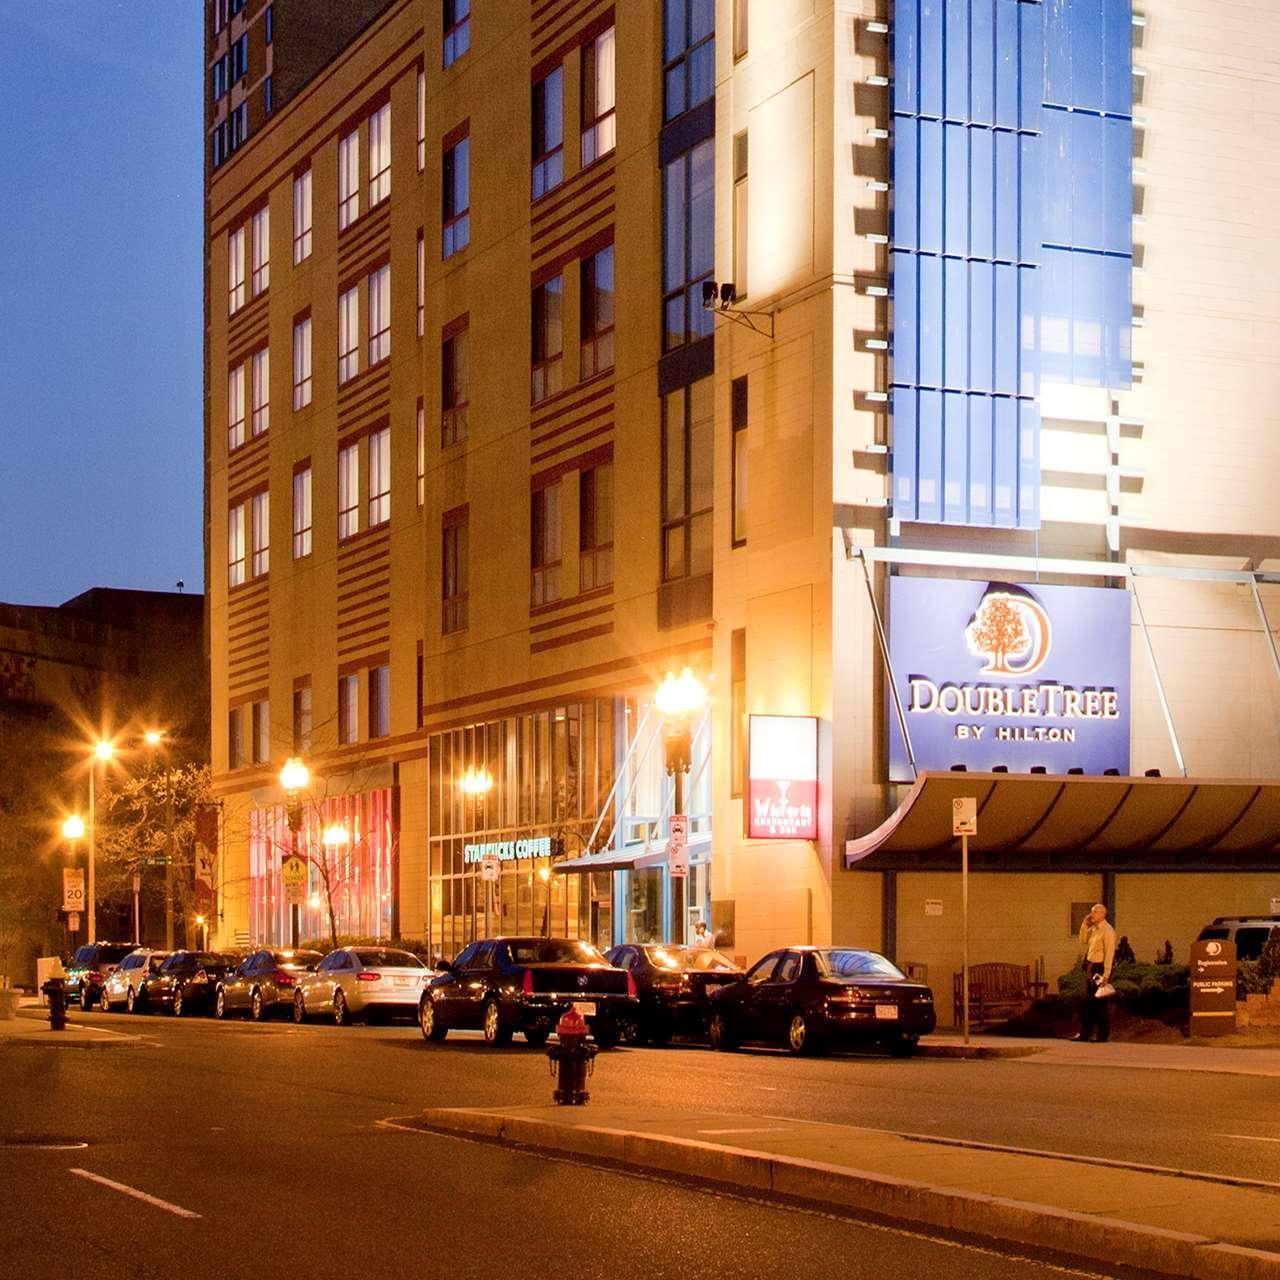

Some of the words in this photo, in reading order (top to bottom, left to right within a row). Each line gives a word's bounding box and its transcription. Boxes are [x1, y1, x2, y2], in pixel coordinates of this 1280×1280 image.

[957, 726, 985, 740] BY
[998, 727, 1076, 742] HILTON
[516, 836, 551, 860] COFFEE
[66, 889, 83, 900] 20
